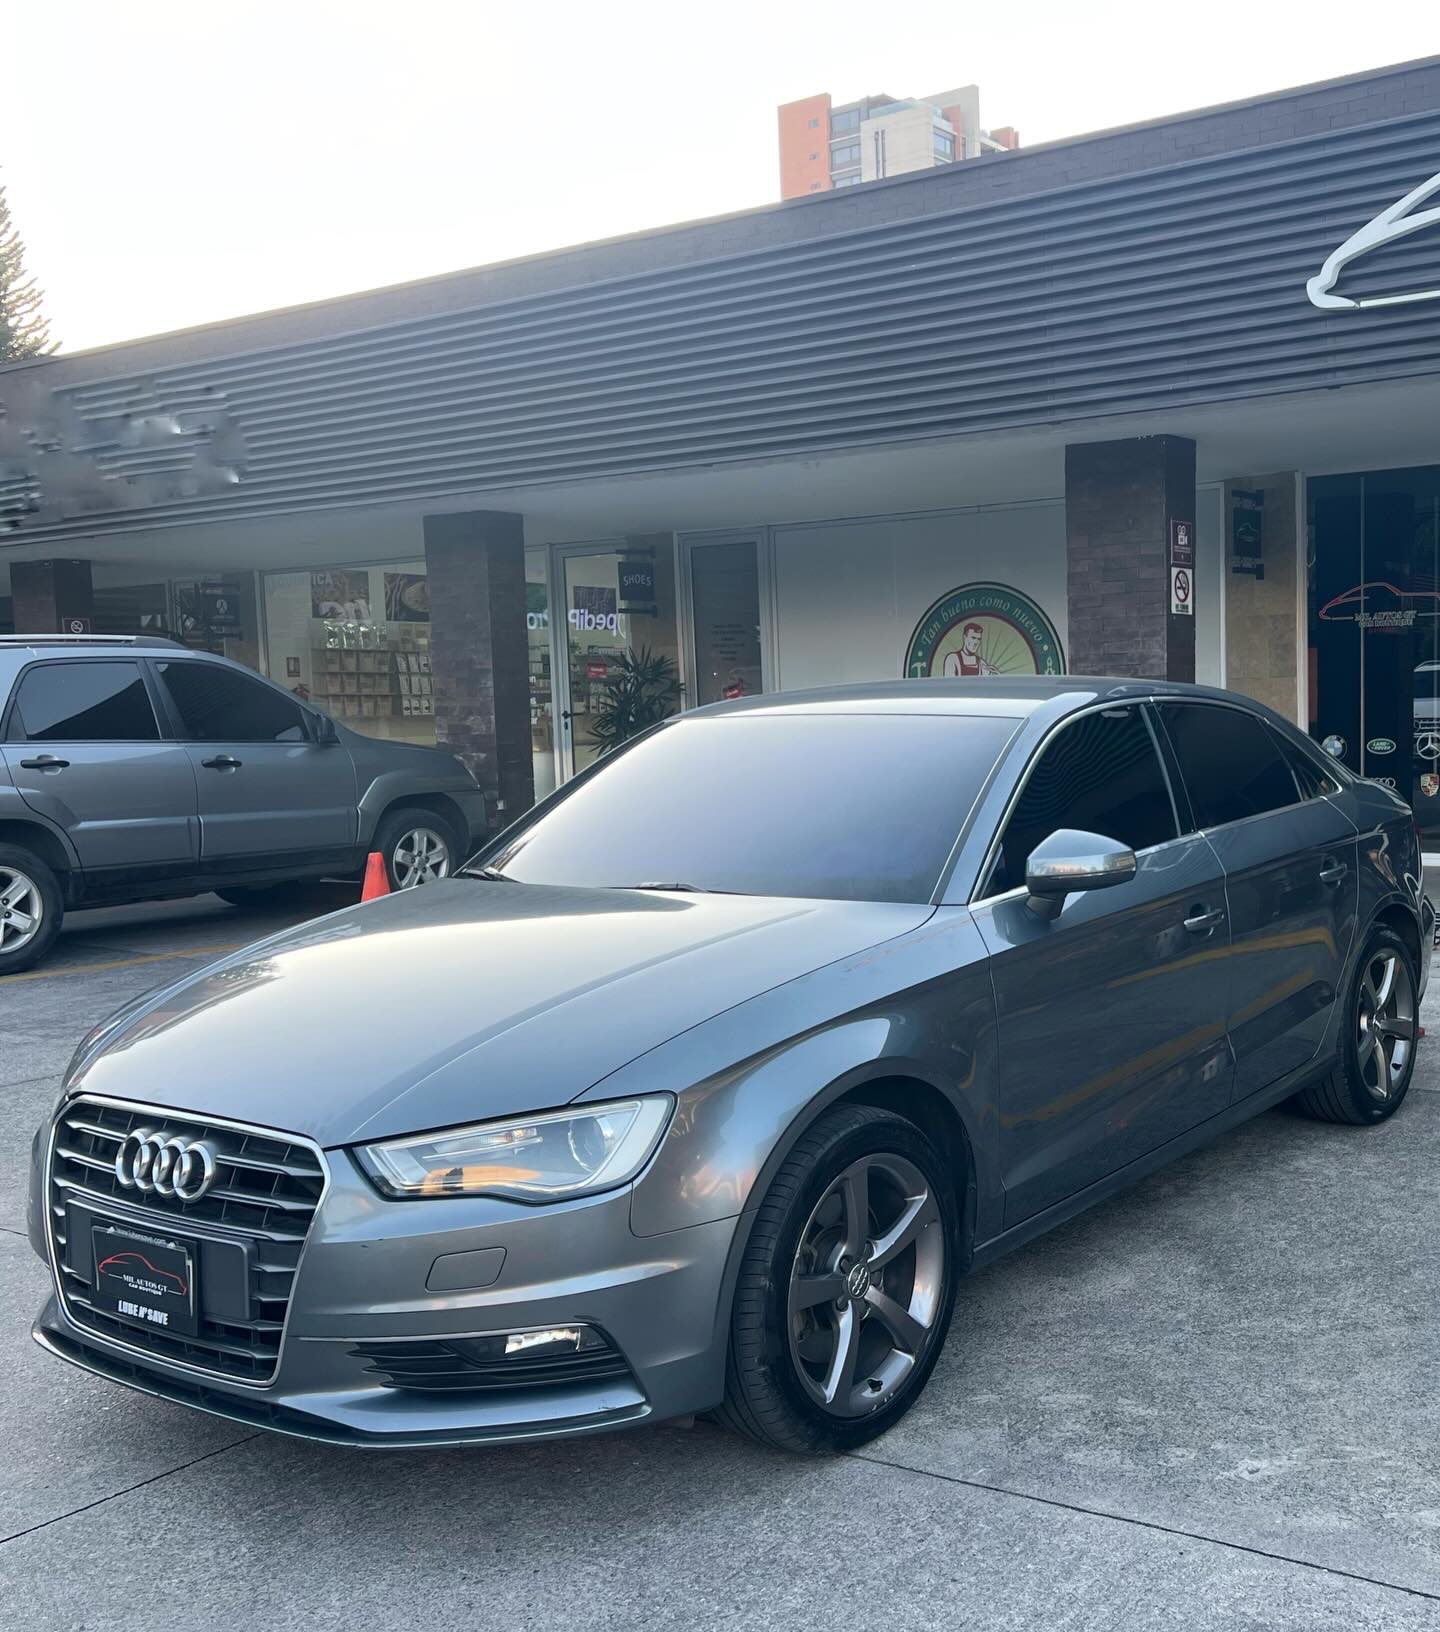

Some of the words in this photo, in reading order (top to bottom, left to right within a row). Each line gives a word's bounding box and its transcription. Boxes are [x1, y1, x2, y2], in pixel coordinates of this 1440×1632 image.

[623, 574, 652, 587] SHOES
[921, 621, 942, 646] Tan
[940, 597, 976, 623] bueno
[979, 596, 1010, 612] como
[1012, 607, 1043, 642] nuevo
[122, 1274, 136, 1284] MIL
[136, 1278, 157, 1290] AUTOS
[158, 1284, 168, 1293] GT
[118, 1299, 139, 1317] LUBE
